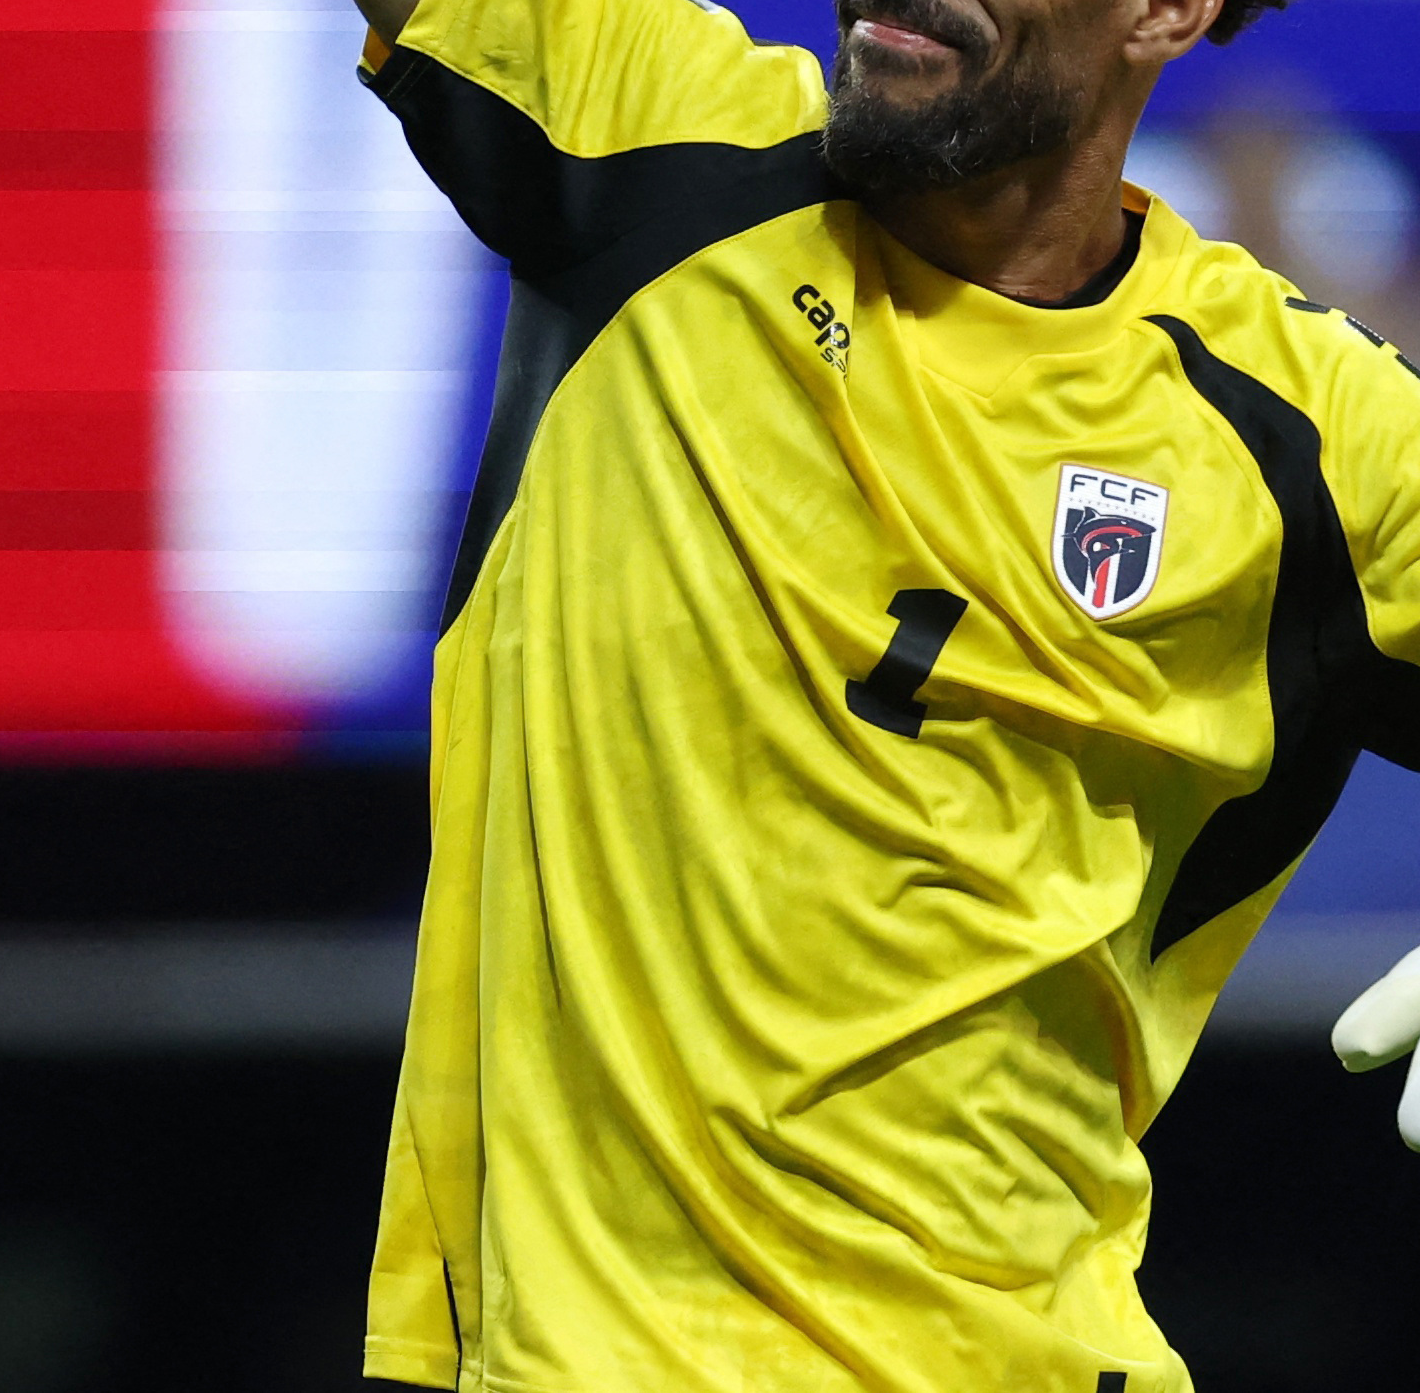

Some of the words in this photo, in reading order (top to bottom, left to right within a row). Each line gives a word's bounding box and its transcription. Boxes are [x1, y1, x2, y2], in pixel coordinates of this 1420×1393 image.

[792, 284, 851, 364] cap
[1070, 473, 1159, 505] FCF
[845, 588, 970, 739] 1
